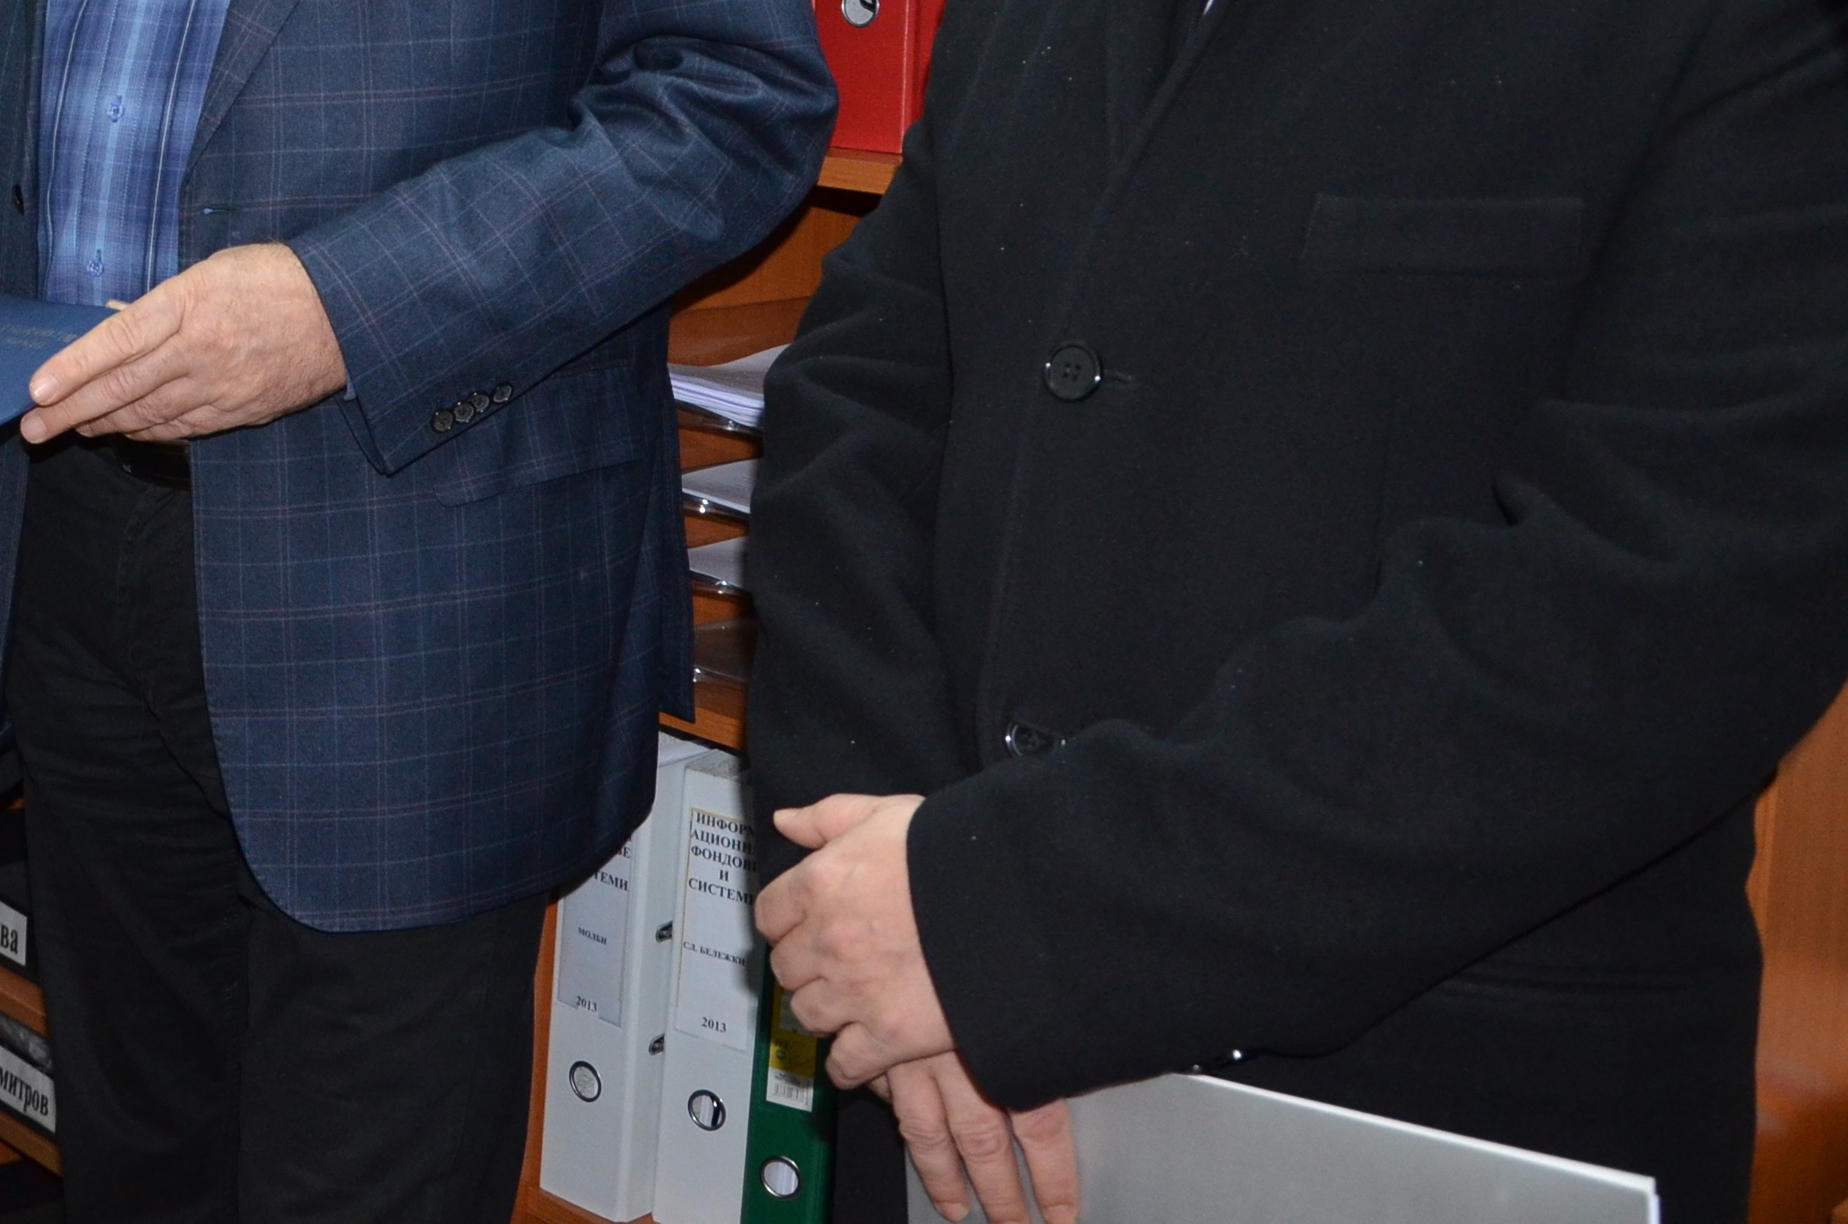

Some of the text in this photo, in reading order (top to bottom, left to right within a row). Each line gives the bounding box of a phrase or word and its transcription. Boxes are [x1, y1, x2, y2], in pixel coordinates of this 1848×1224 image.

[719, 869, 729, 882] И
[576, 995, 598, 1013] 2013
[701, 1016, 728, 1033] 2013
